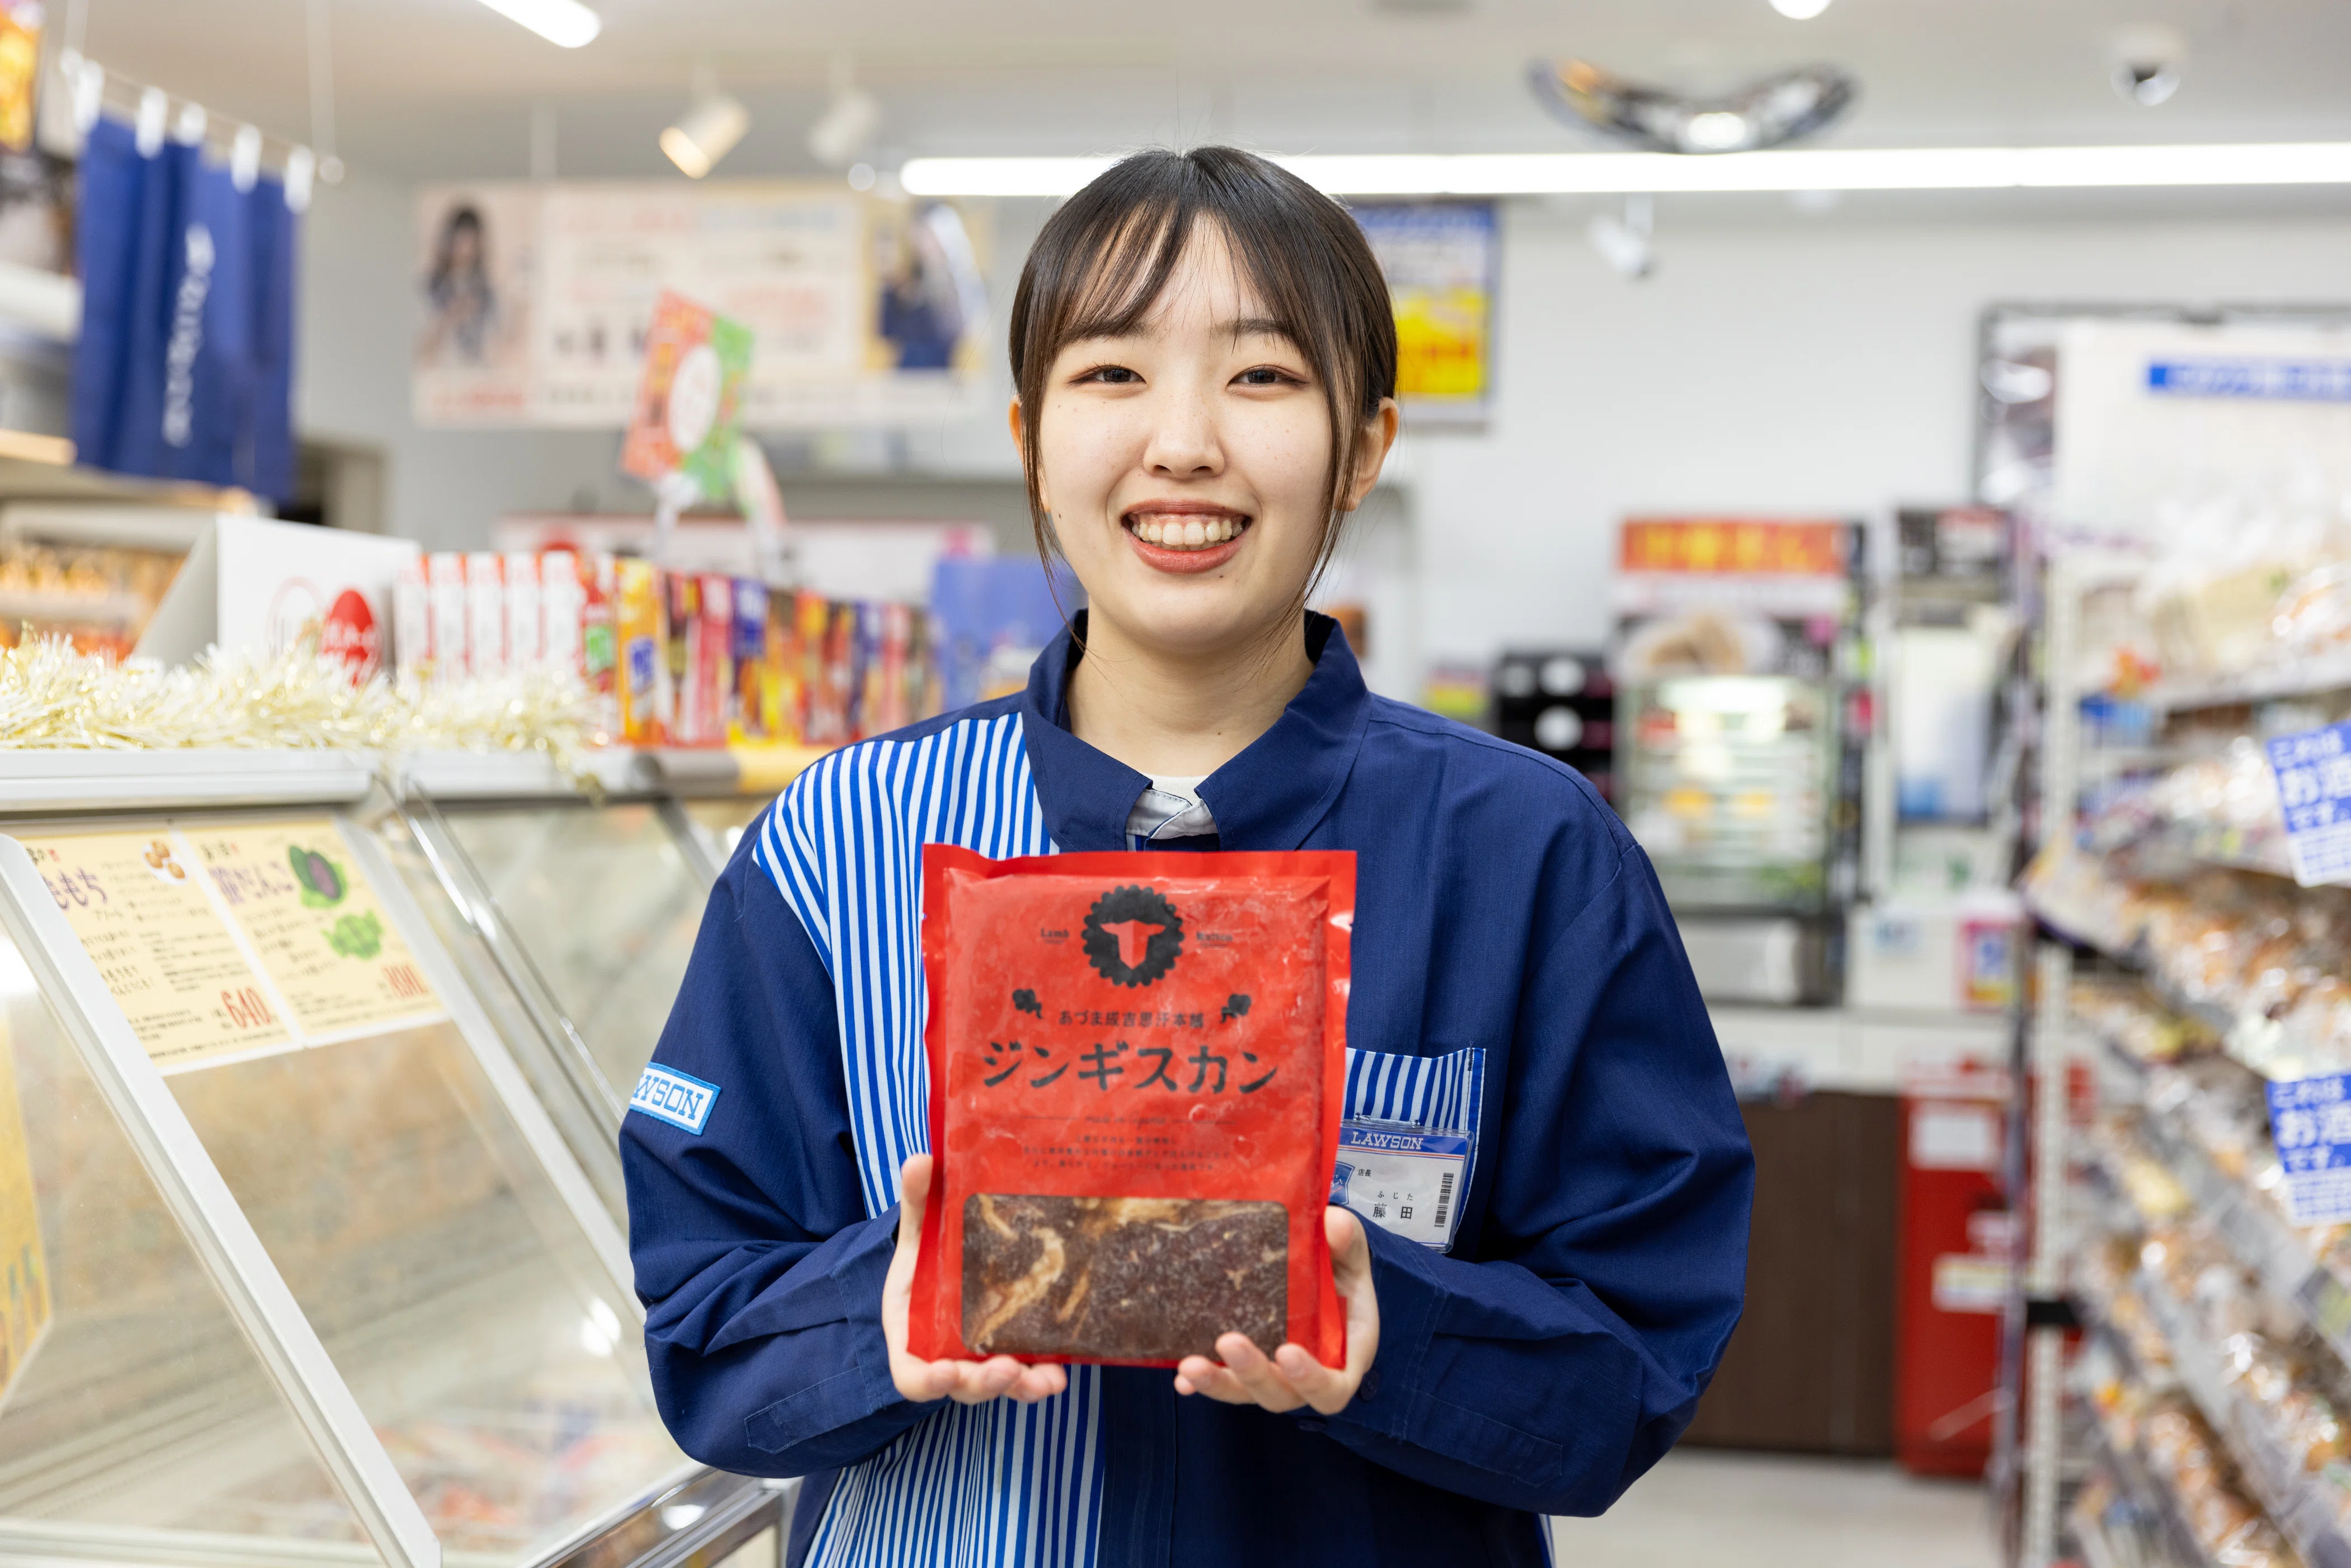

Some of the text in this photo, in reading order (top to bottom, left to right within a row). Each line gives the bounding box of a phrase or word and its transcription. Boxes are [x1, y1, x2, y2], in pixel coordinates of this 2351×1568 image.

[1040, 928, 1069, 938] Lamb
[221, 986, 271, 1029] 640
[983, 1040, 1278, 1095] ジンギスカン
[1351, 1131, 1423, 1150] LAWSON
[1357, 1168, 1371, 1177] 店長
[1378, 1191, 1413, 1201] ふじた
[1373, 1203, 1413, 1219] 藤田
